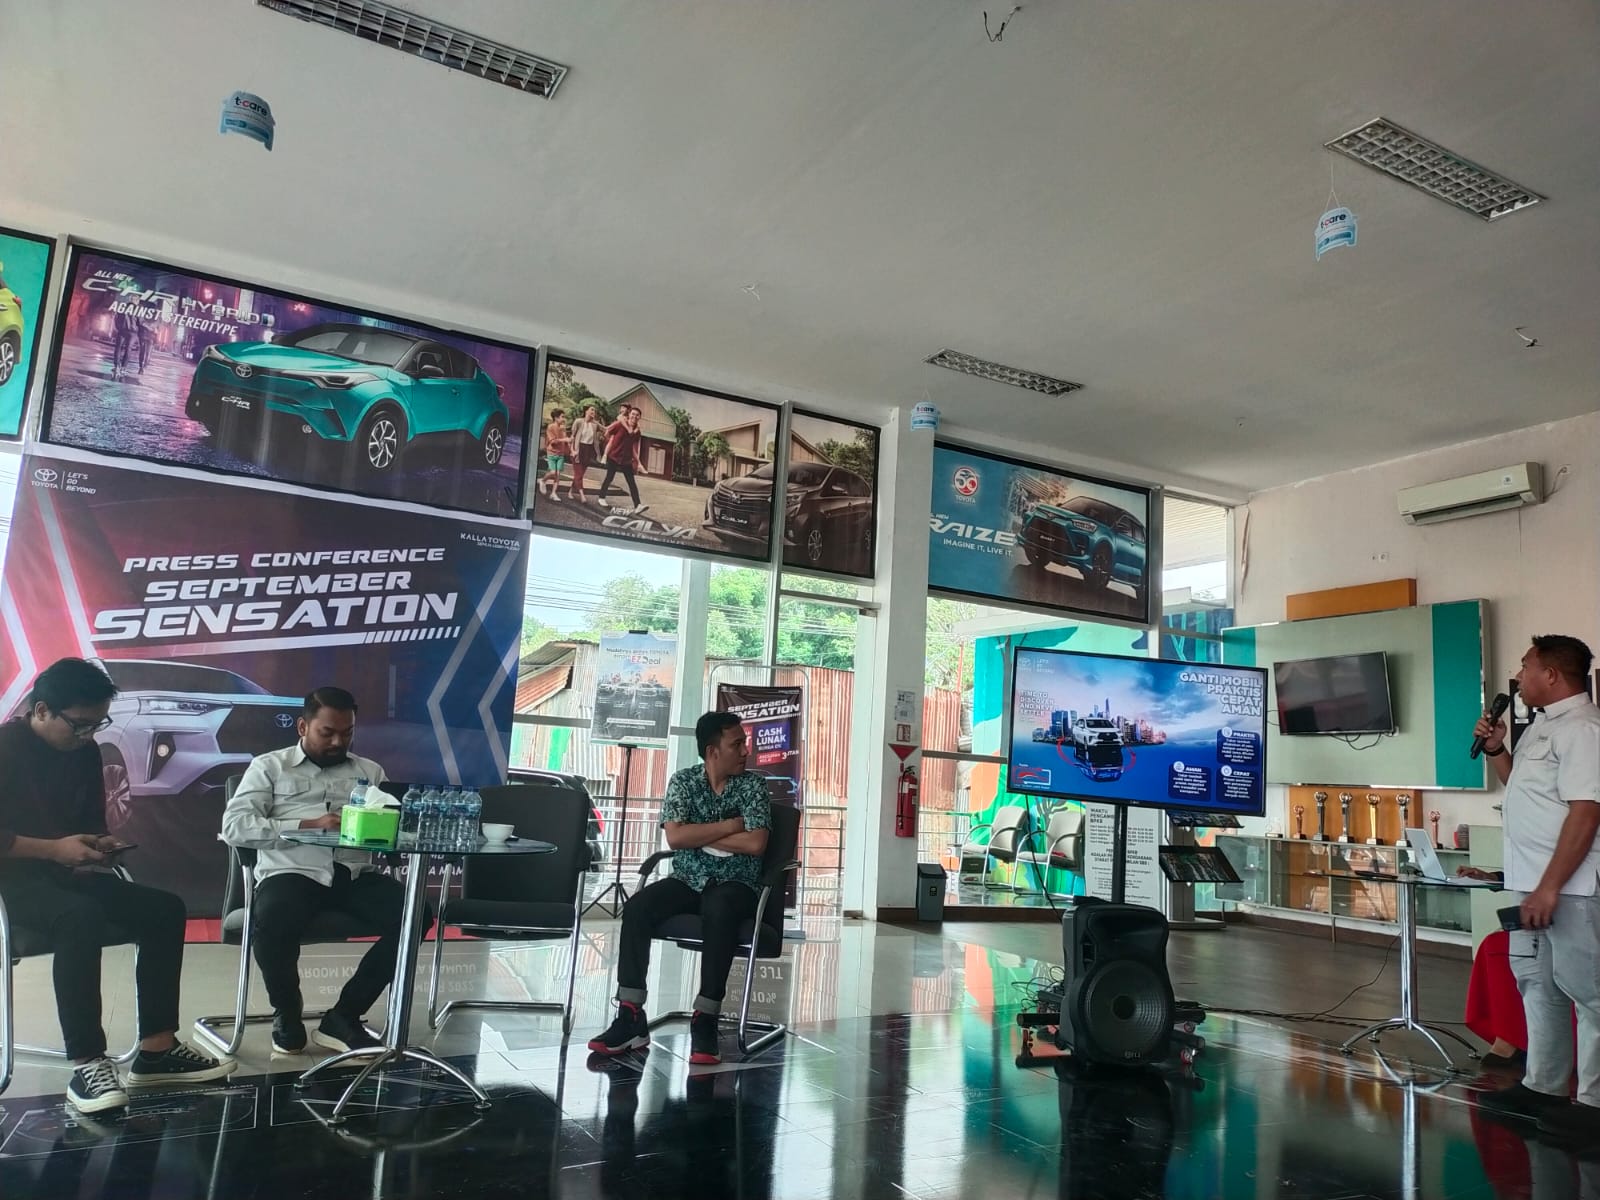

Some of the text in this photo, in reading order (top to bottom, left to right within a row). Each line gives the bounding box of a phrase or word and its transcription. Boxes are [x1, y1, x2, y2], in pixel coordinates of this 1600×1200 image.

[94, 270, 135, 282] ALL NEW
[108, 301, 239, 337] AGAINST STEREOTYPE
[67, 471, 89, 480] LET'S
[31, 480, 58, 489] TOYOTA
[65, 485, 97, 495] BEYOND
[609, 506, 634, 516] NEW
[601, 515, 698, 540] CALYA
[929, 518, 1018, 546] RAIZE
[460, 532, 487, 543] KALLA
[488, 536, 520, 547] TOYOTA
[943, 538, 976, 550] IMAGINE
[987, 546, 1004, 555] LIVE
[122, 547, 446, 573] PRESS CONFERENCE
[144, 571, 412, 602] SEPTEMBER
[90, 592, 459, 642] SENSATION
[1180, 672, 1262, 688] GANTI MOBIL
[1207, 684, 1261, 697] PRAKTIS
[727, 699, 789, 713] SEPTEMBER
[1221, 695, 1261, 707] CEPAT
[732, 703, 801, 719] NSATION
[1222, 704, 1261, 716] AMAN
[758, 726, 783, 737] CASH
[756, 734, 787, 746] LUNAK
